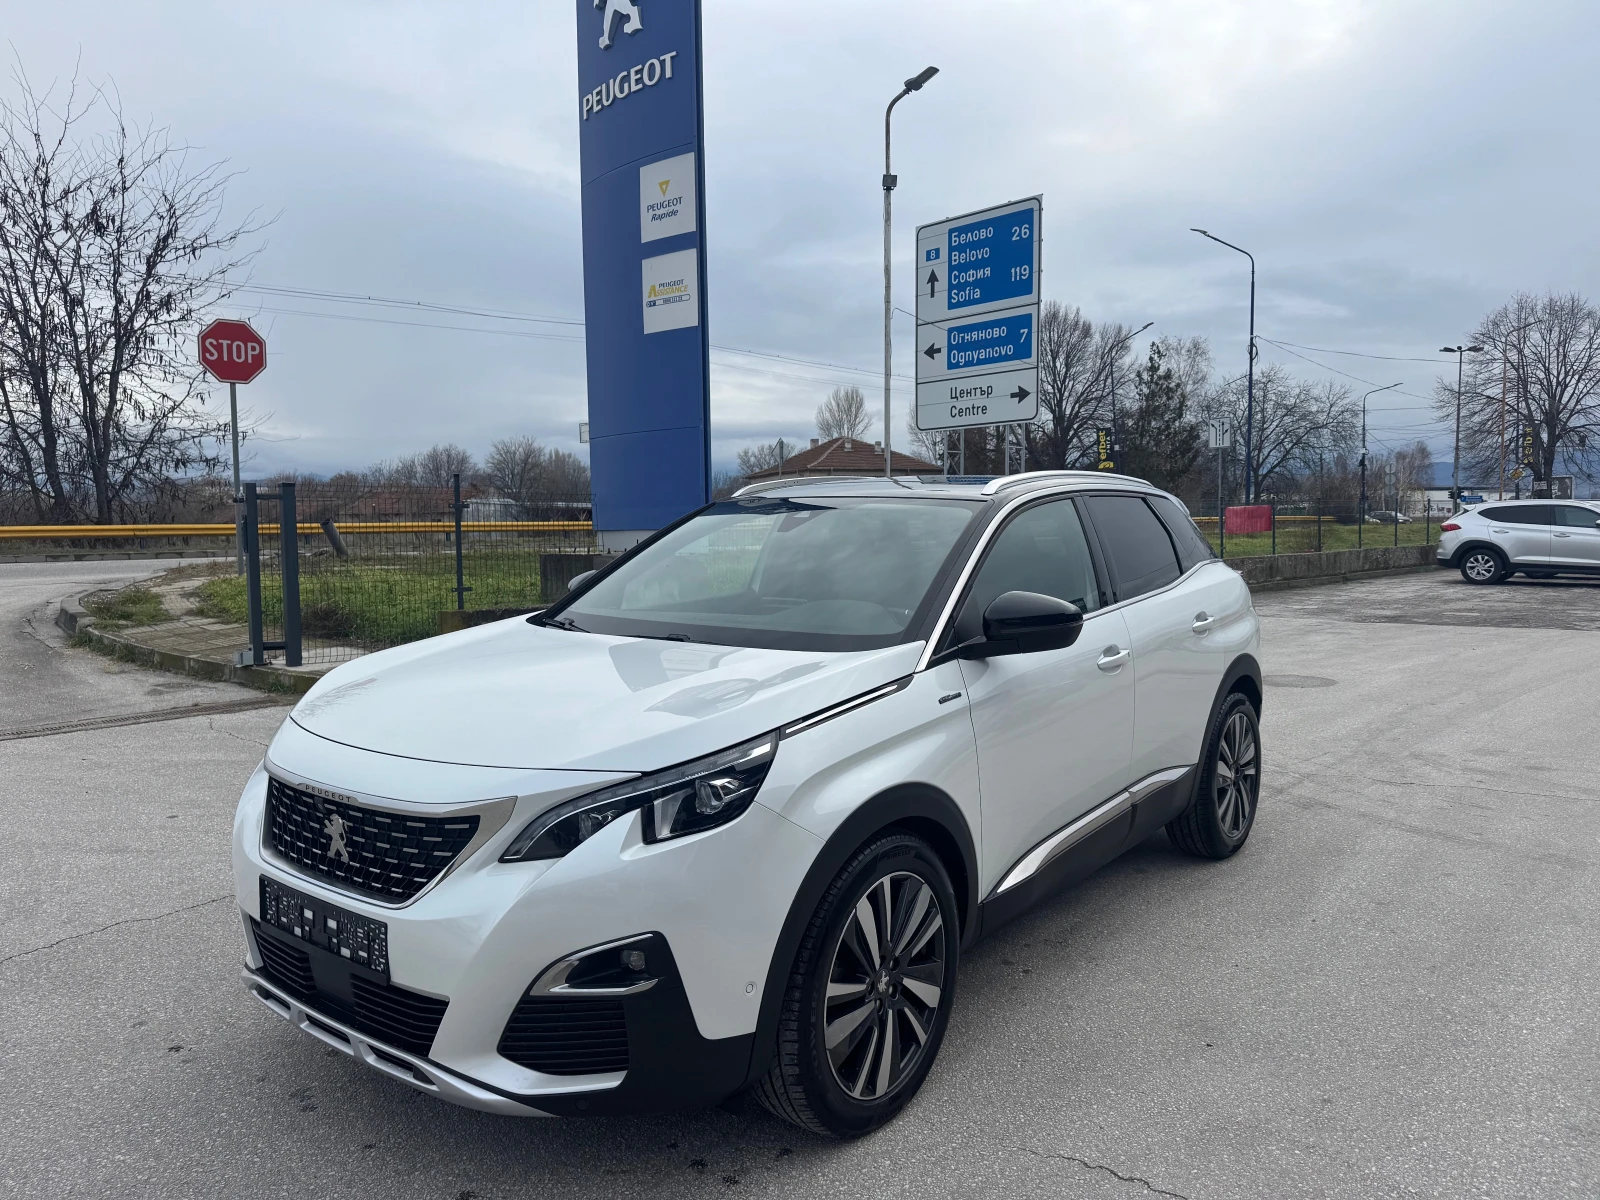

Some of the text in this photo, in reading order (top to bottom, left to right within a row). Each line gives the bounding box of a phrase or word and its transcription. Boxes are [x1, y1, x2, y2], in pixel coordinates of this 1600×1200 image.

[582, 51, 678, 120] PEUGEOT
[646, 196, 683, 213] PEUGEOT
[651, 208, 679, 222] Rapide
[951, 224, 1030, 246] Белово 26
[930, 250, 936, 260] 8
[951, 247, 990, 265] Belovo
[951, 265, 1030, 284] София 119
[658, 279, 685, 289] PEUGEOT
[951, 287, 980, 303] Sofia
[950, 326, 1029, 345] Огняново 7
[205, 338, 260, 364] STOP
[950, 344, 1014, 365] Ognyanovo
[950, 385, 993, 401] Център
[950, 403, 988, 418] Centre
[305, 784, 351, 802] PEUGEOT
